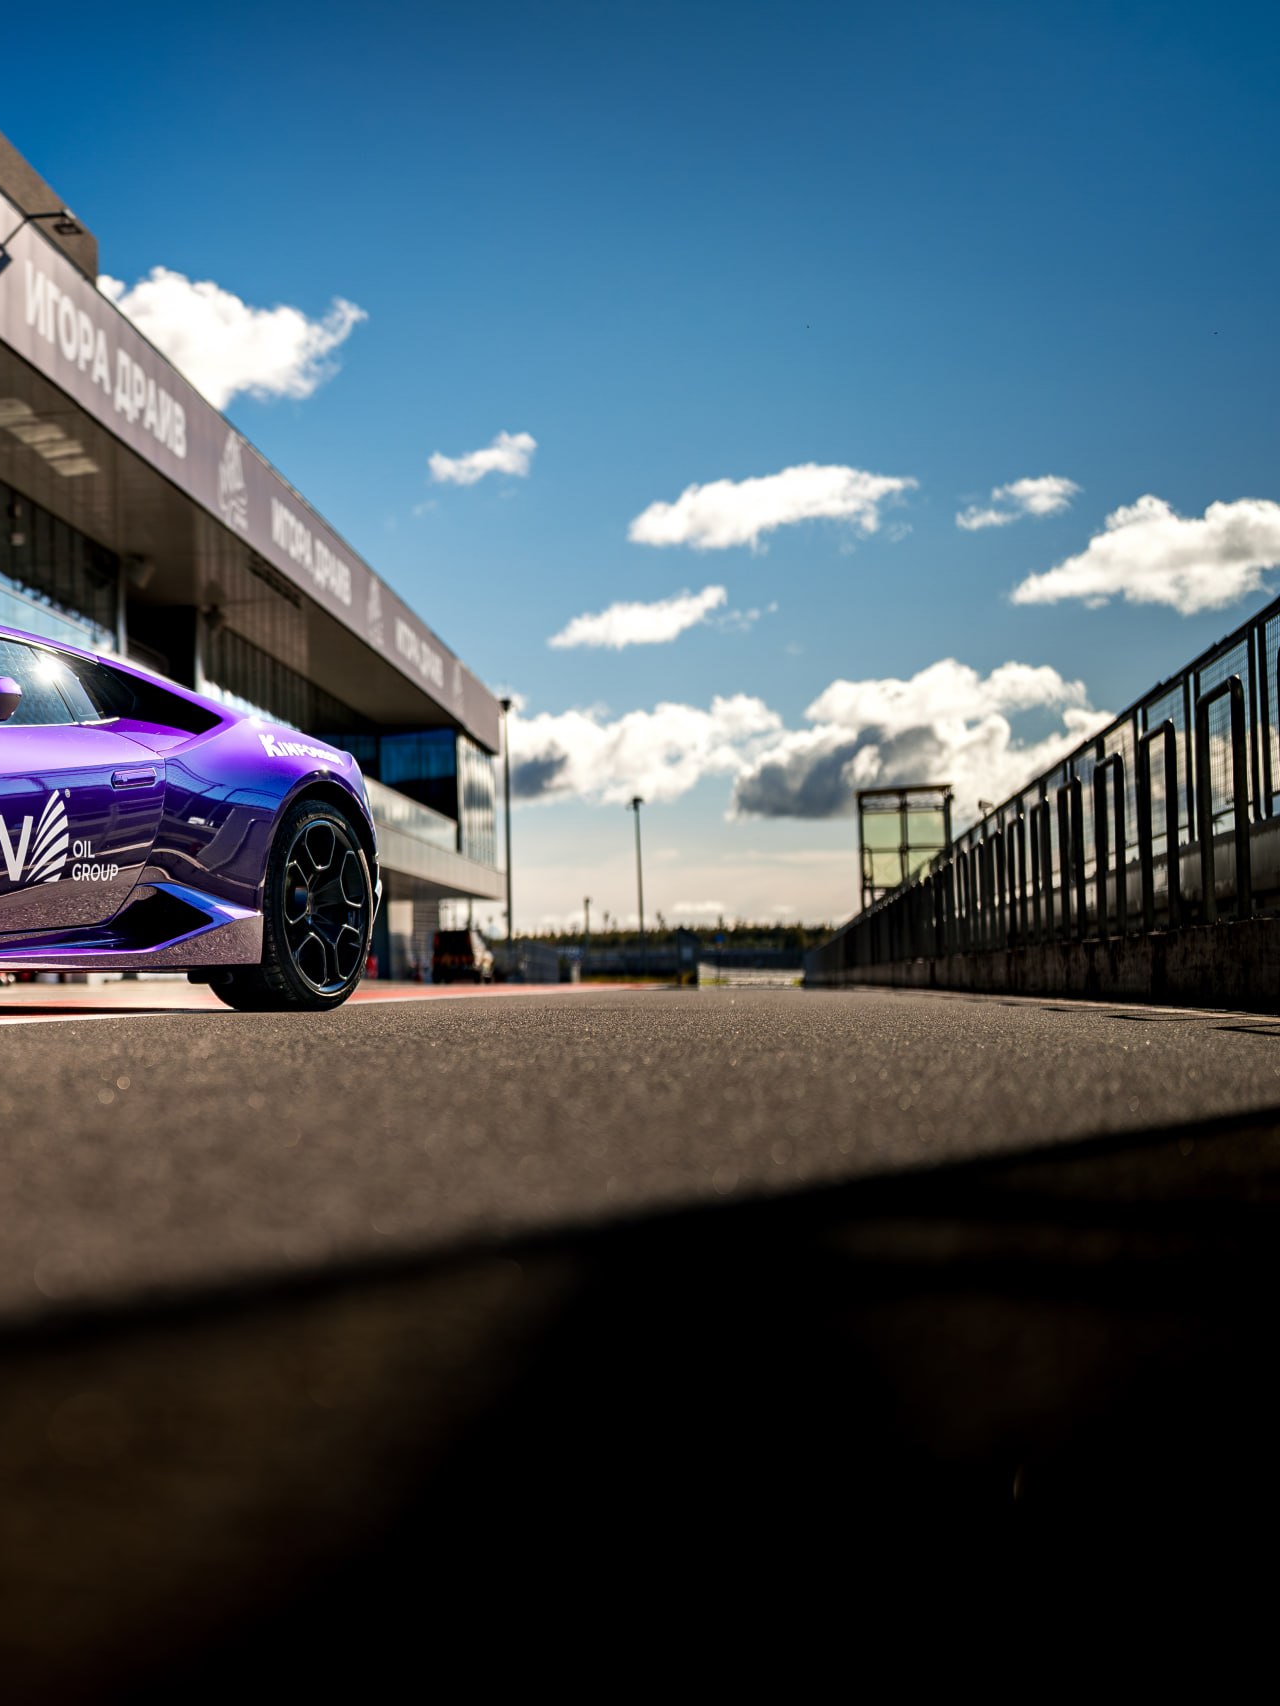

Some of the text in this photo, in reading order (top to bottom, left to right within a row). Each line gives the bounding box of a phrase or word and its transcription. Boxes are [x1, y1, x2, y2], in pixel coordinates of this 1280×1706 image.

[24, 259, 111, 395] ИГОРА
[73, 840, 96, 858] OIL
[72, 863, 118, 881] GROUP
